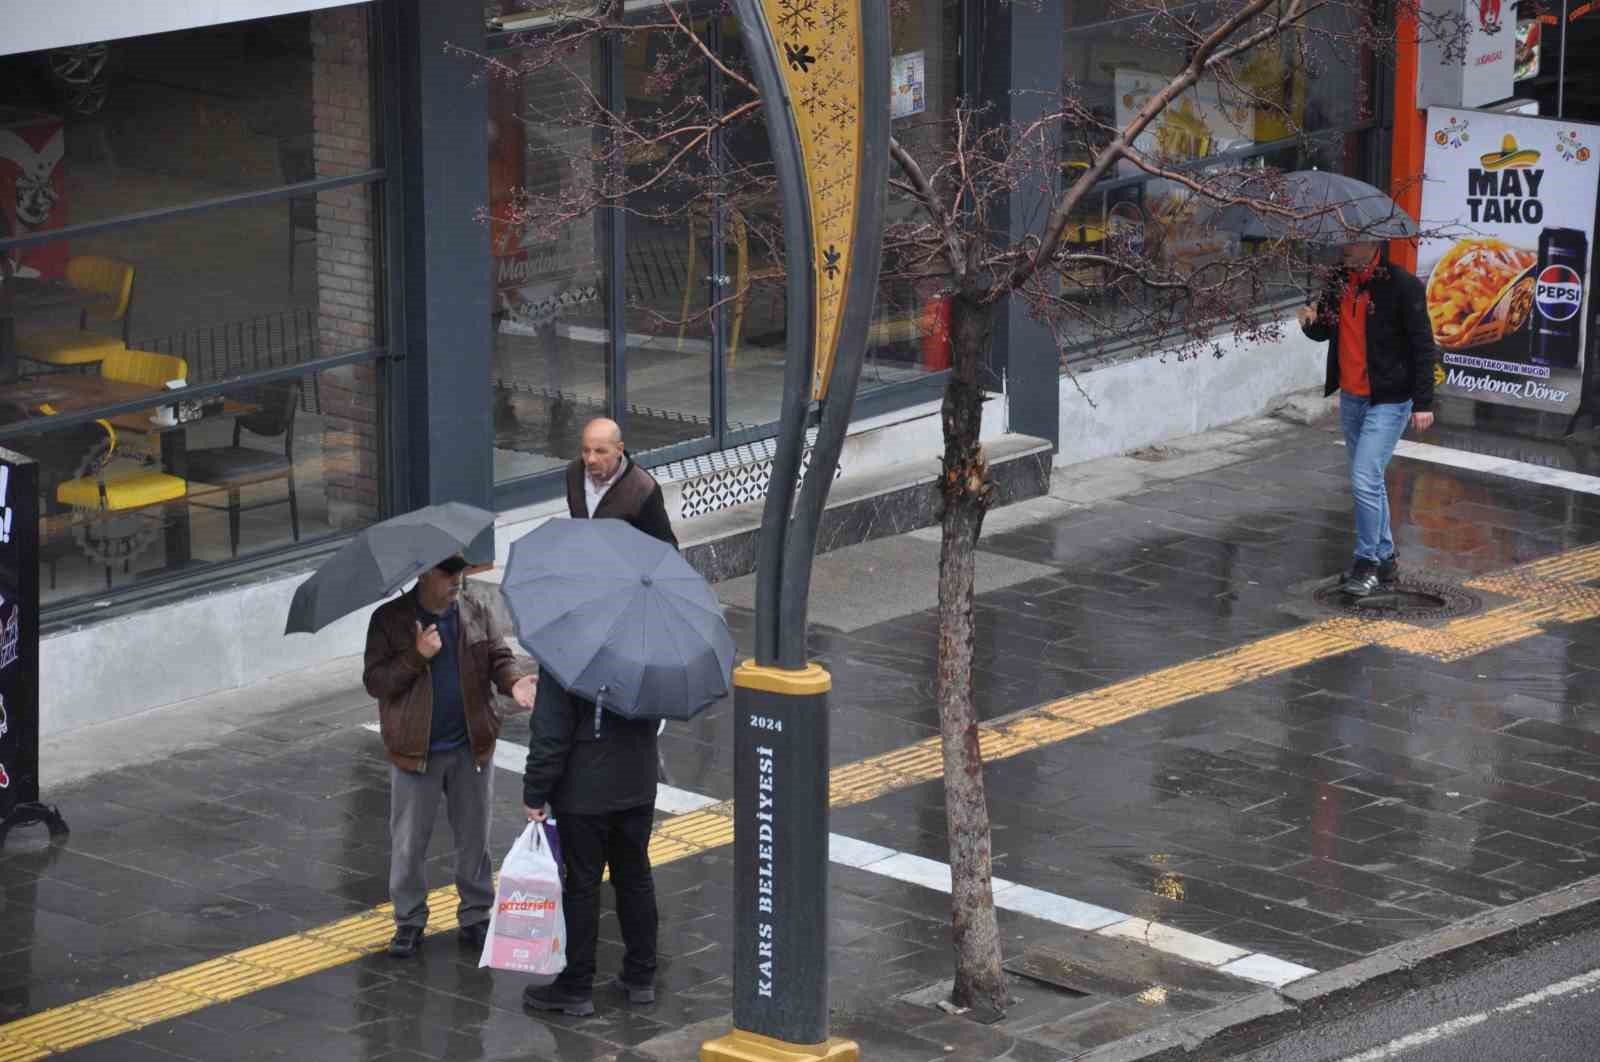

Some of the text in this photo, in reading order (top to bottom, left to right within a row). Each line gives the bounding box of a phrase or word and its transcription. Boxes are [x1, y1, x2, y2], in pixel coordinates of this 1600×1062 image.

[1468, 168, 1544, 197] MAY
[1466, 198, 1544, 224] TAKO
[1537, 286, 1580, 302] PEPSI
[1446, 367, 1570, 403] Maydonoz Döner
[749, 715, 783, 733] 2024
[757, 746, 774, 998] KARS BELEDİYESİ
